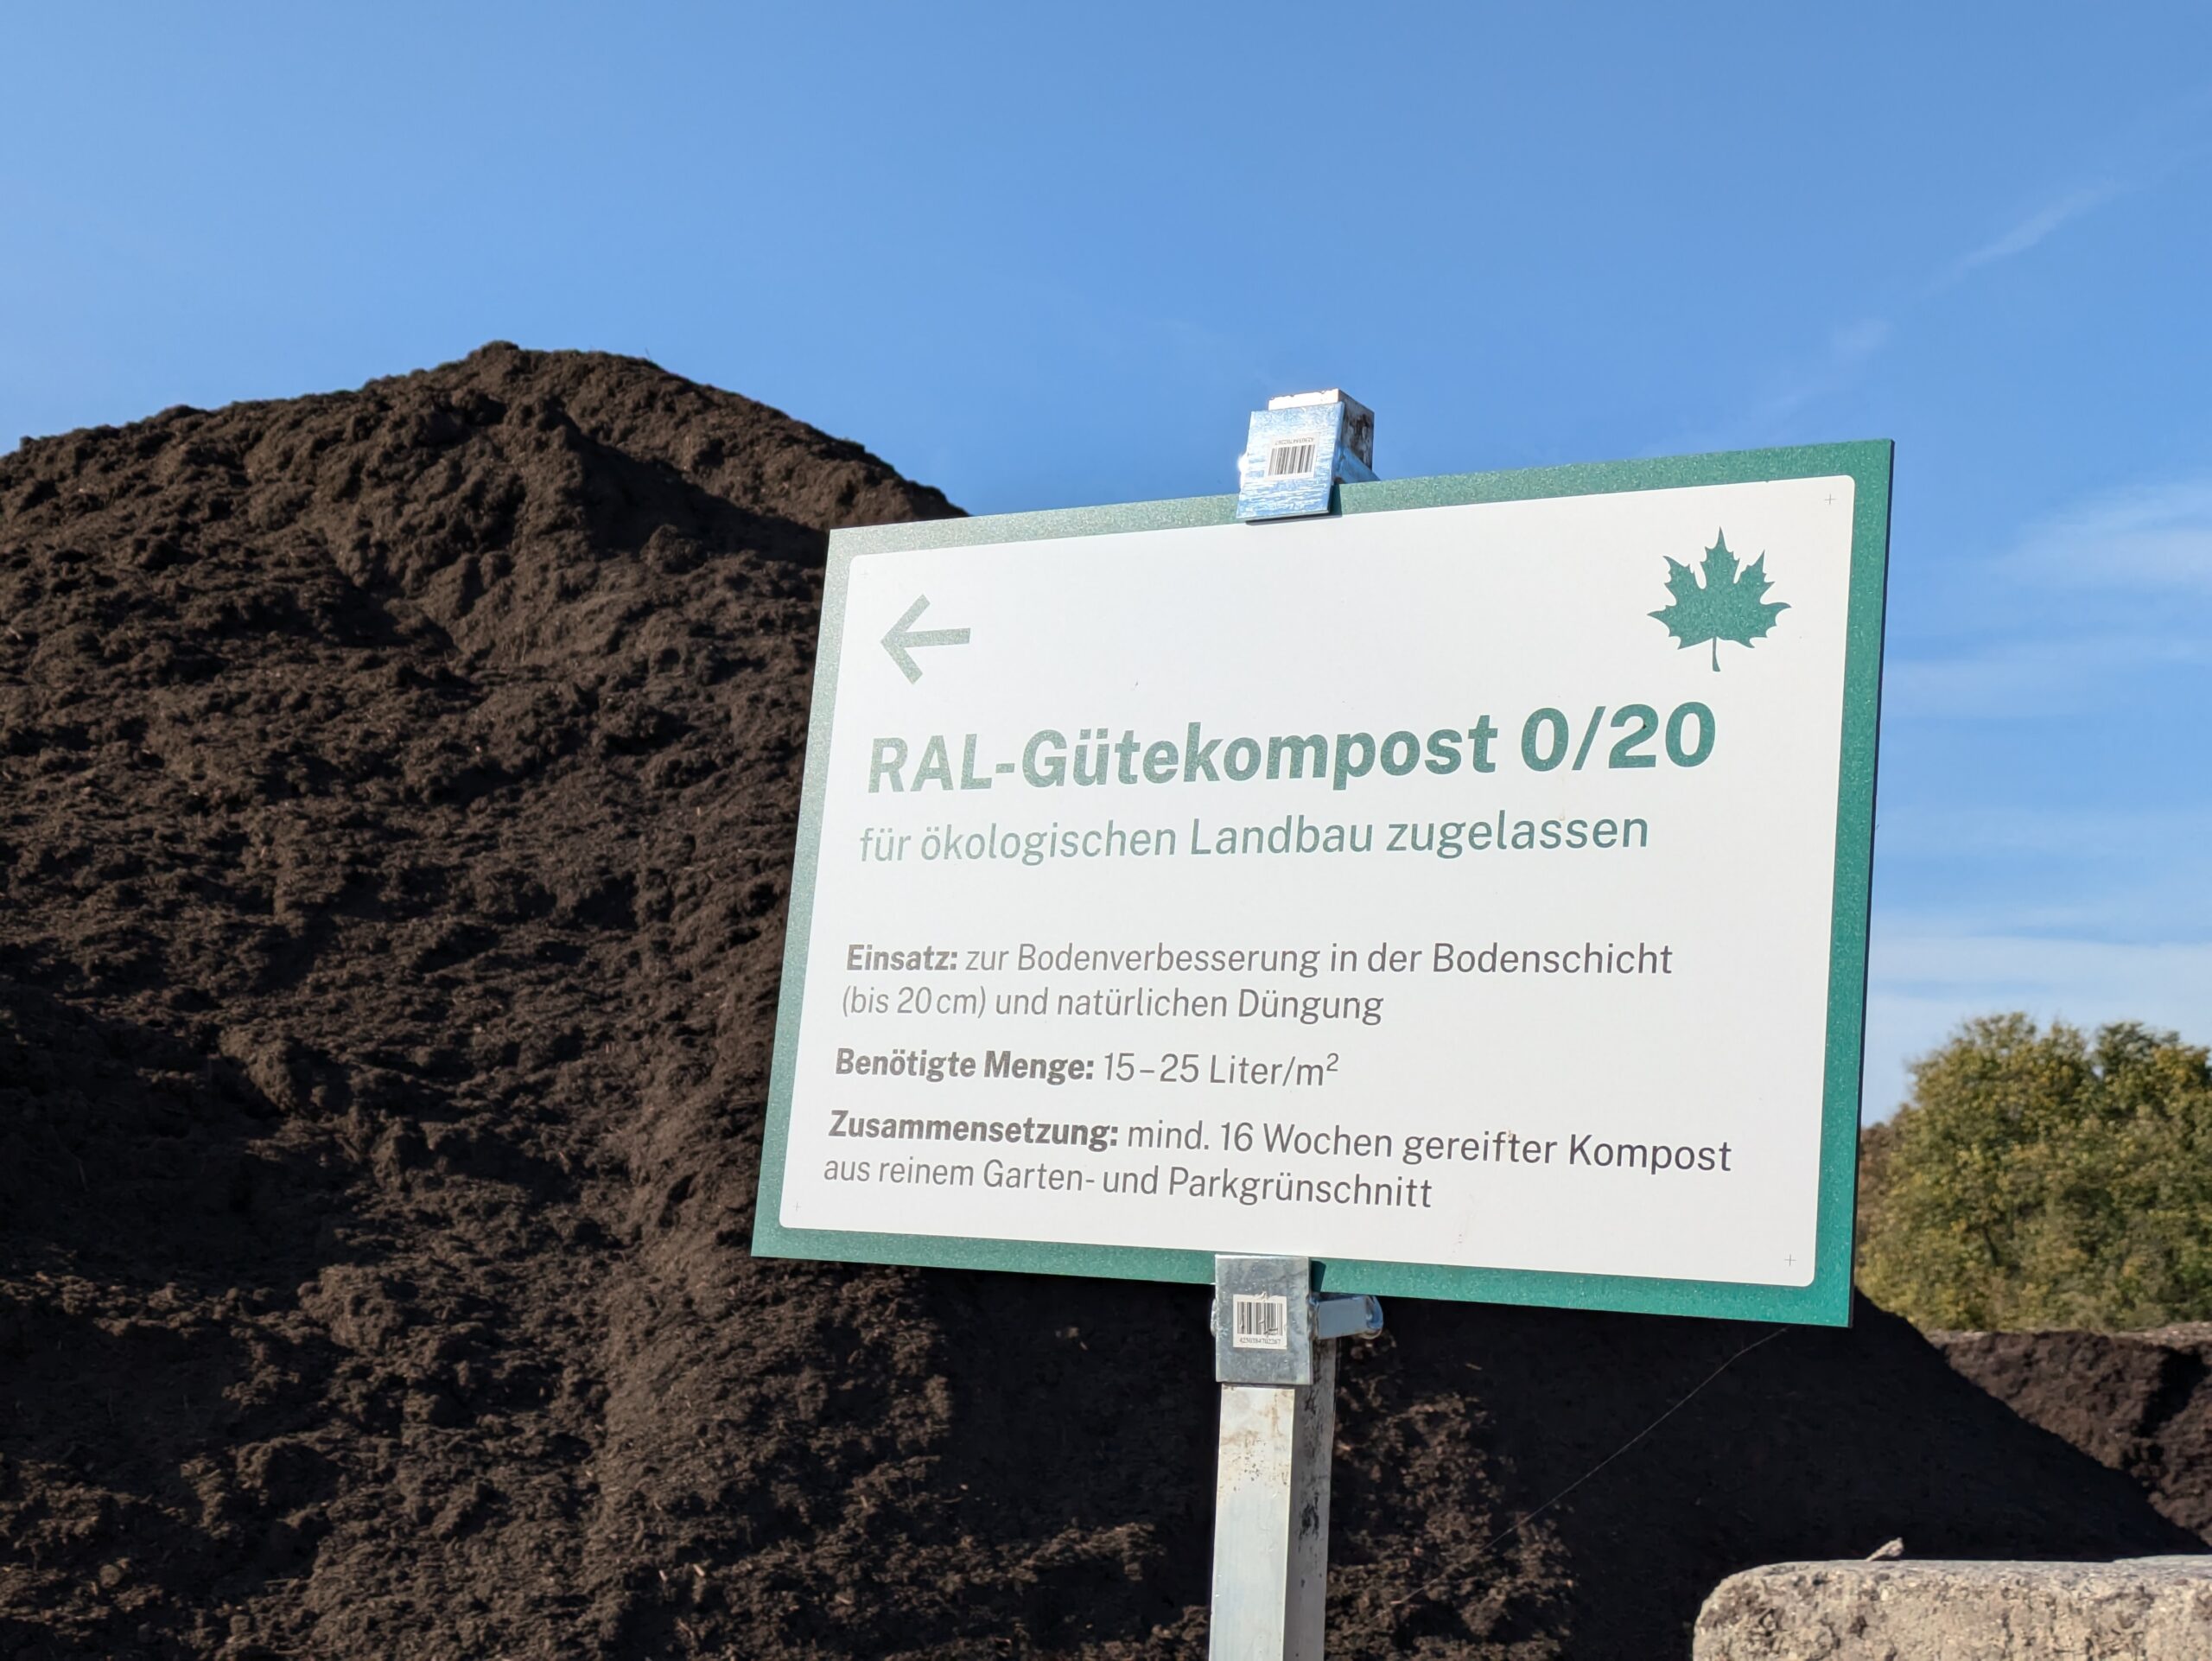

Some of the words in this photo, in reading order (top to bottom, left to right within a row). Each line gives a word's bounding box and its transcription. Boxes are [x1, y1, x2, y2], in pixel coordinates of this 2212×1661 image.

[868, 715, 1498, 792] RAL-Gütekompost
[1521, 702, 1715, 772] 0/20
[861, 828, 911, 861] für
[921, 820, 1175, 866] ökologischen
[1192, 815, 1372, 855] Landbau
[1387, 810, 1647, 859] zugelassen
[847, 945, 957, 971] Einsatz:
[965, 951, 1009, 971] zur
[1018, 942, 1320, 977] Bodenverbesserung
[1331, 943, 1357, 971] in
[1368, 942, 1422, 972] der
[1433, 942, 1673, 974] Bodenschicht
[843, 986, 888, 1017] (bis
[996, 987, 1048, 1015] und
[1058, 987, 1227, 1016] natürlichen
[1239, 989, 1383, 1025] Düngung
[836, 1048, 976, 1082] Benötigte
[984, 1051, 1094, 1085] Menge:
[829, 1110, 1118, 1152] Zusammensetzung:
[1128, 1120, 1209, 1149] mind.
[1221, 1122, 1253, 1151] 16
[1263, 1123, 1392, 1157] Wochen
[1402, 1130, 1558, 1165] gereifter
[1570, 1134, 1732, 1174] Kompost
[823, 1161, 870, 1181] aus
[880, 1156, 974, 1186] reinem
[984, 1159, 1095, 1191] Garten-
[1103, 1165, 1159, 1194] und
[1169, 1165, 1432, 1207] Parkgrünschnitt
